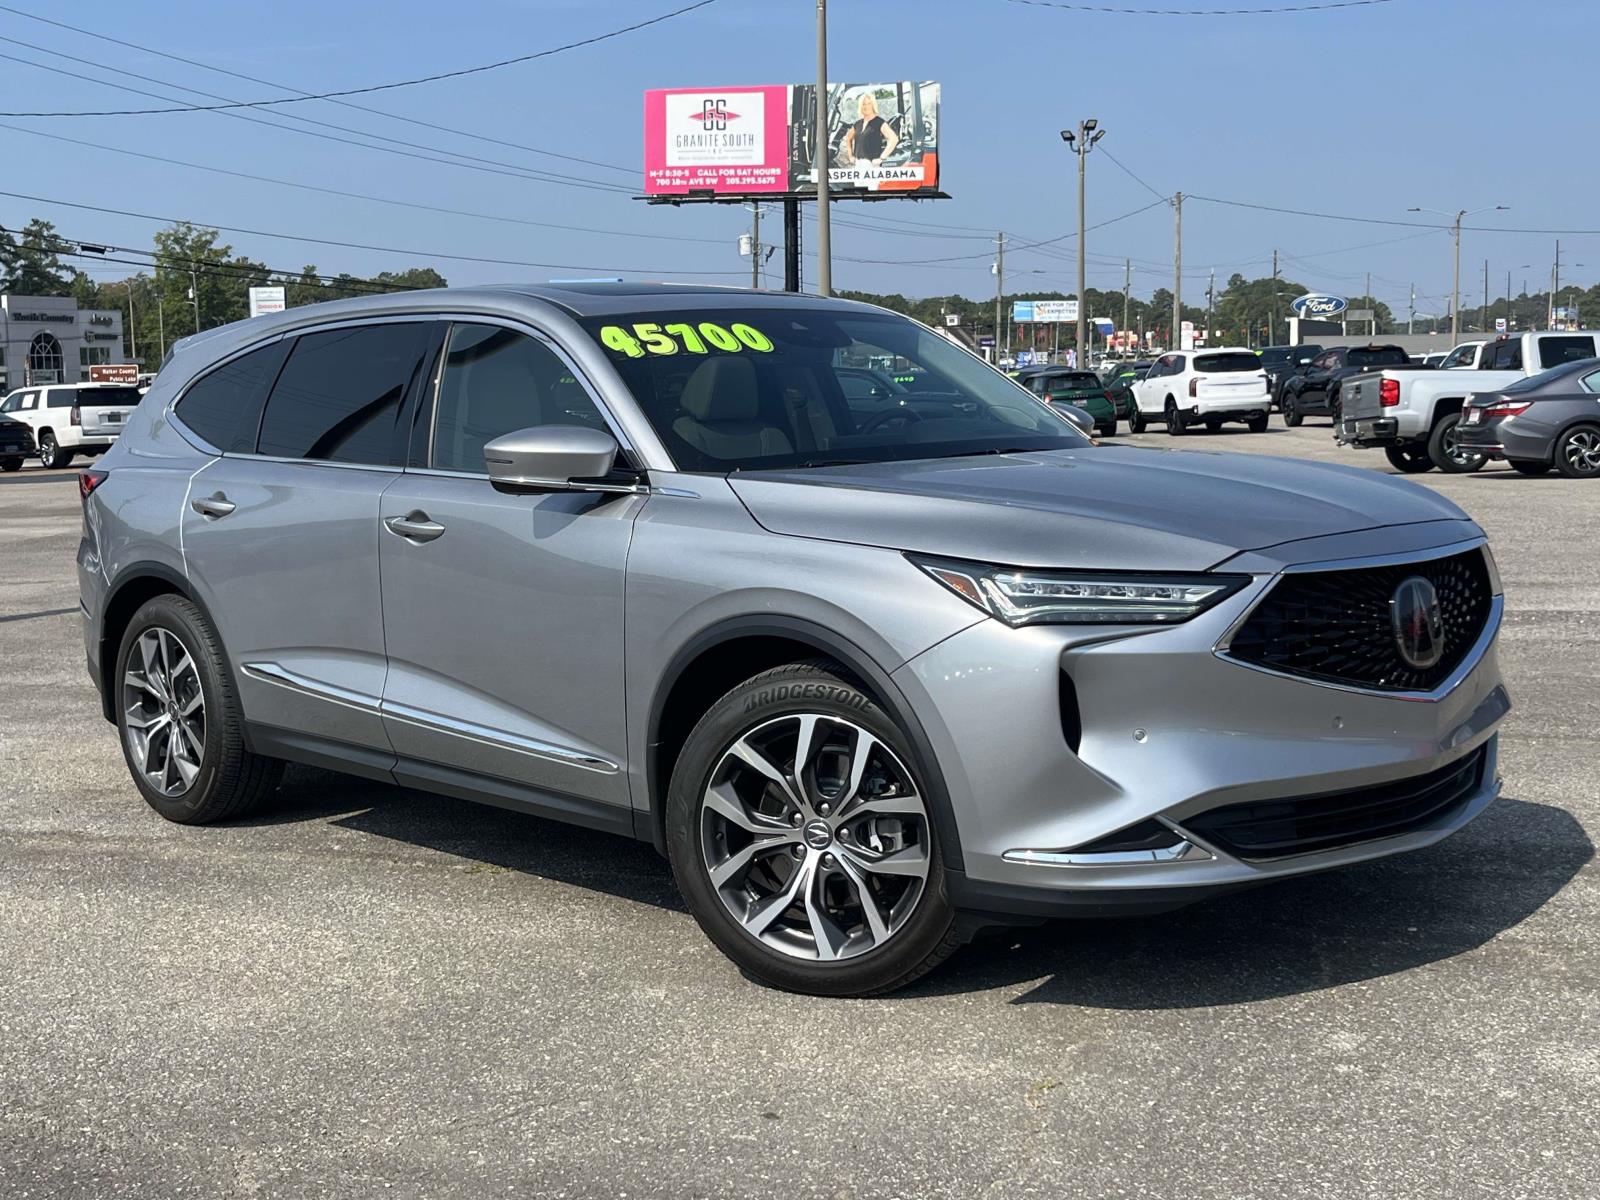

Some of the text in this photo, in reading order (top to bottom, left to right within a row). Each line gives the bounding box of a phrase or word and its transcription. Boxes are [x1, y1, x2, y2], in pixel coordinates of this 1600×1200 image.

[676, 133, 754, 148] GRANITE SOUTH
[705, 177, 718, 185] SW
[827, 170, 916, 180] ASPER ALABAMA
[1306, 297, 1337, 312] Ford
[600, 322, 775, 358] 45700
[743, 684, 873, 714] BRIDGESTONE
